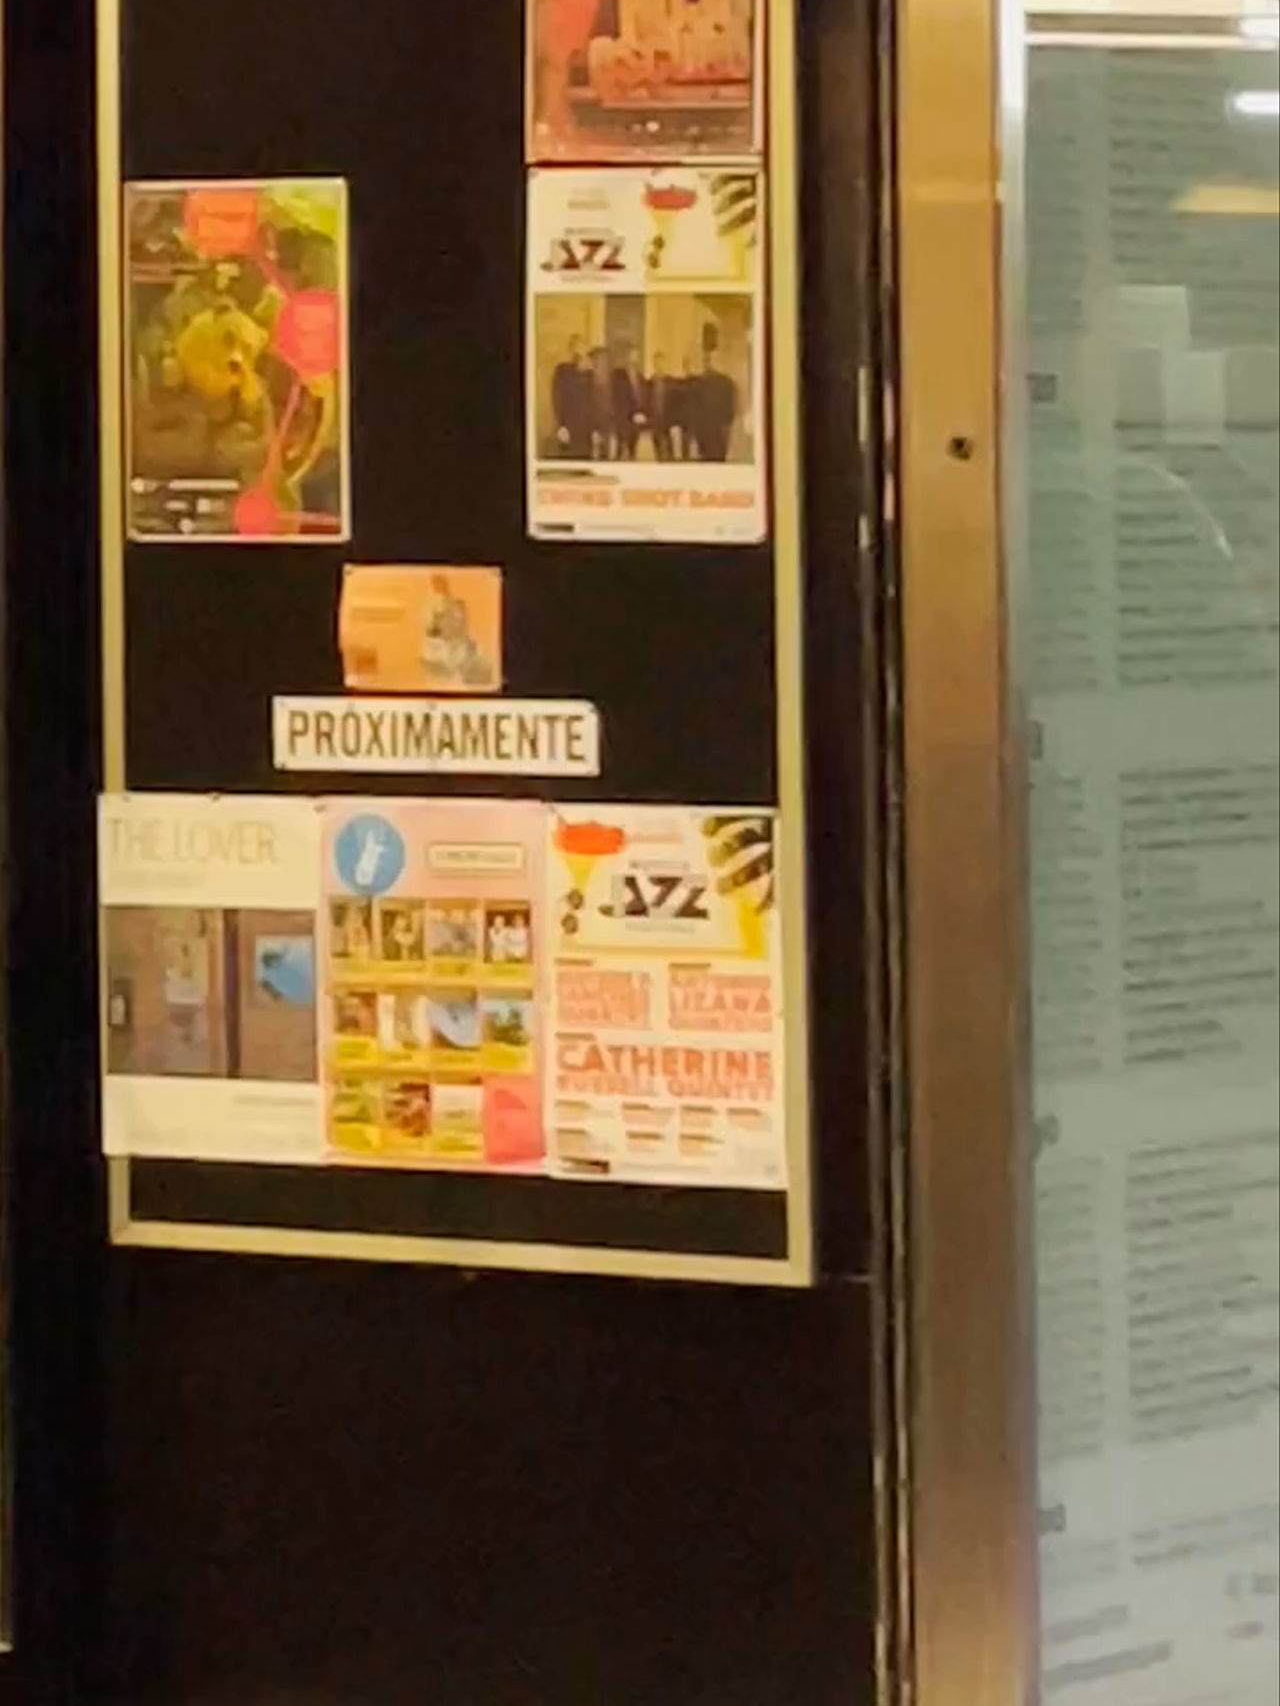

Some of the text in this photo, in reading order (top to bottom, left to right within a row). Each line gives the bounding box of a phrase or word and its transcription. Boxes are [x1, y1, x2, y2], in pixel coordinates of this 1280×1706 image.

[287, 702, 587, 762] PRÓXIMAMENTE
[107, 818, 279, 865] THE LOVER
[556, 1044, 770, 1077] CATHERINE
